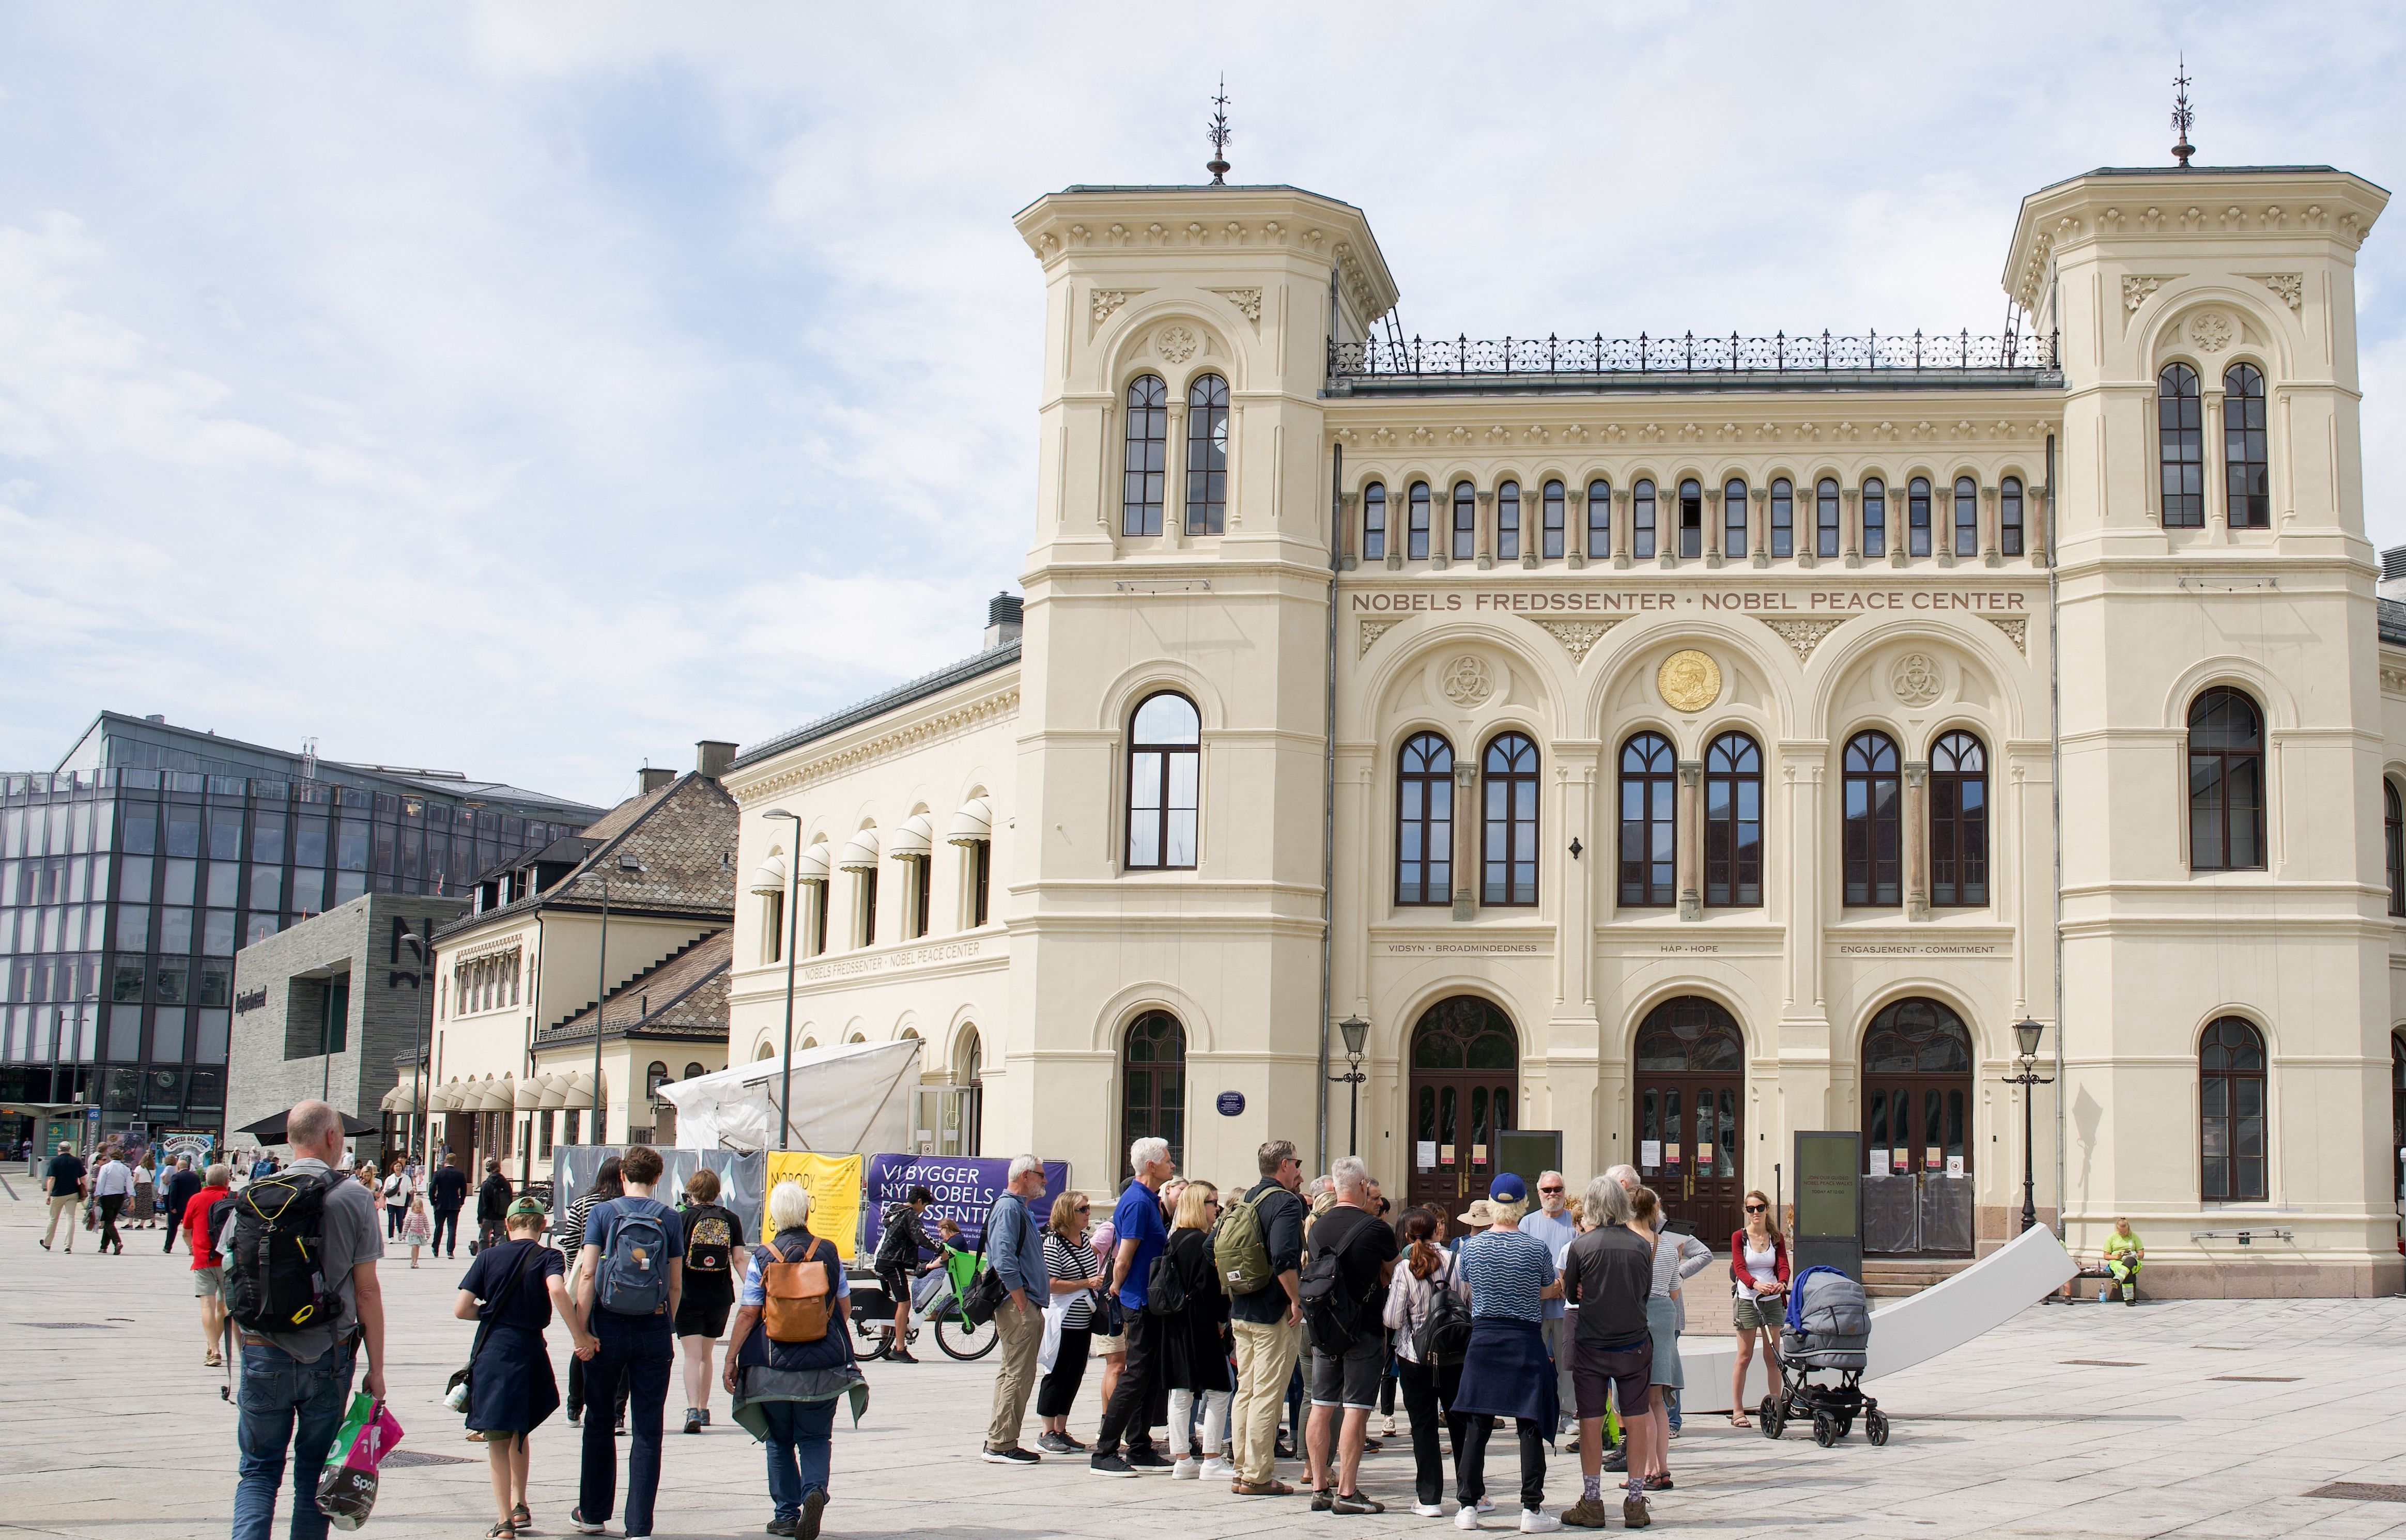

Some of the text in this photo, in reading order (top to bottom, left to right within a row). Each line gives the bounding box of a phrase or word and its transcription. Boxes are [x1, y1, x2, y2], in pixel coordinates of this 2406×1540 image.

[1352, 593, 2024, 611] NOBELS FREDSSENTER NOBEL PEACE CENTER
[1660, 944, 1682, 953] HÅP
[805, 942, 979, 981] NOBELS FREDSSENTER NOBEL PEACE CENTER
[882, 1164, 980, 1184] VI BYGGER
[923, 1294, 944, 1316] Lime
